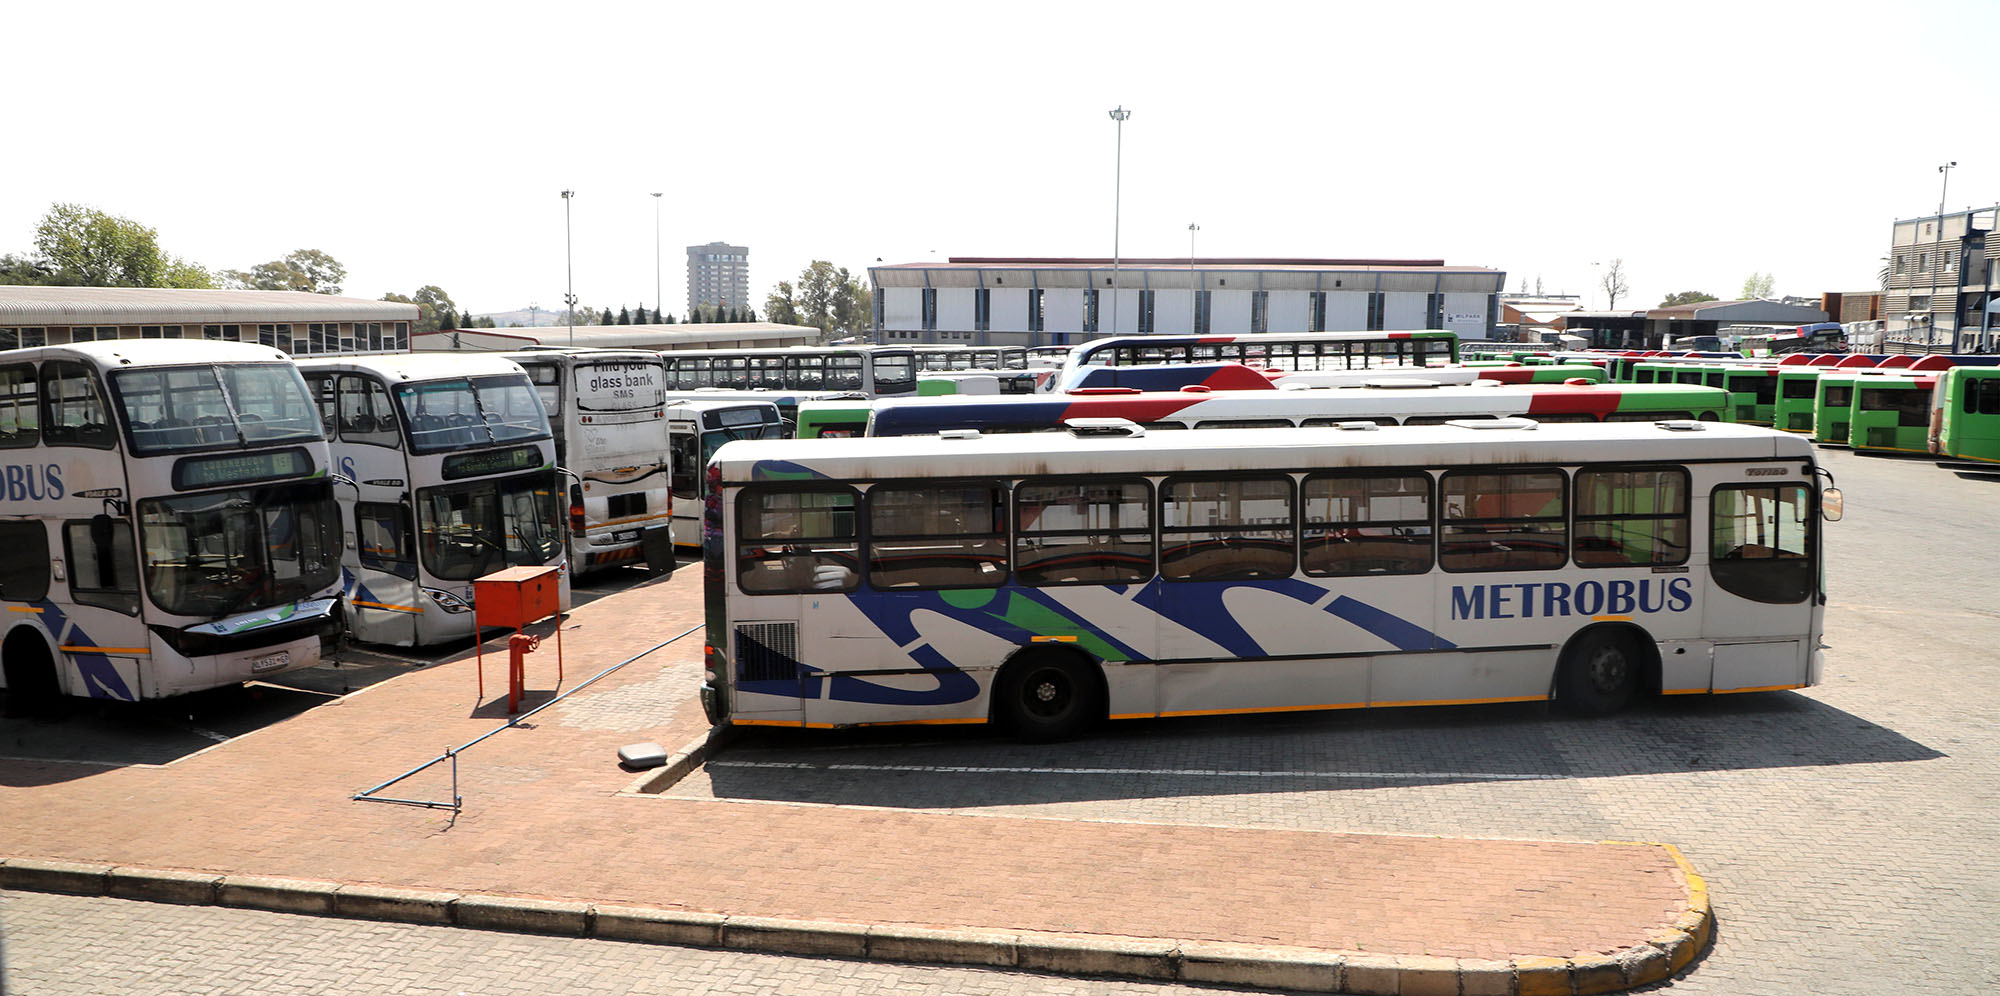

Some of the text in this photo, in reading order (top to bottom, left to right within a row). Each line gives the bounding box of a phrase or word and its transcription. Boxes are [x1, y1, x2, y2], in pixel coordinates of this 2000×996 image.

[593, 359, 647, 374] Find your
[590, 373, 653, 392] glass bank
[613, 390, 634, 399] SMS
[1452, 577, 1693, 621] METROBUS
